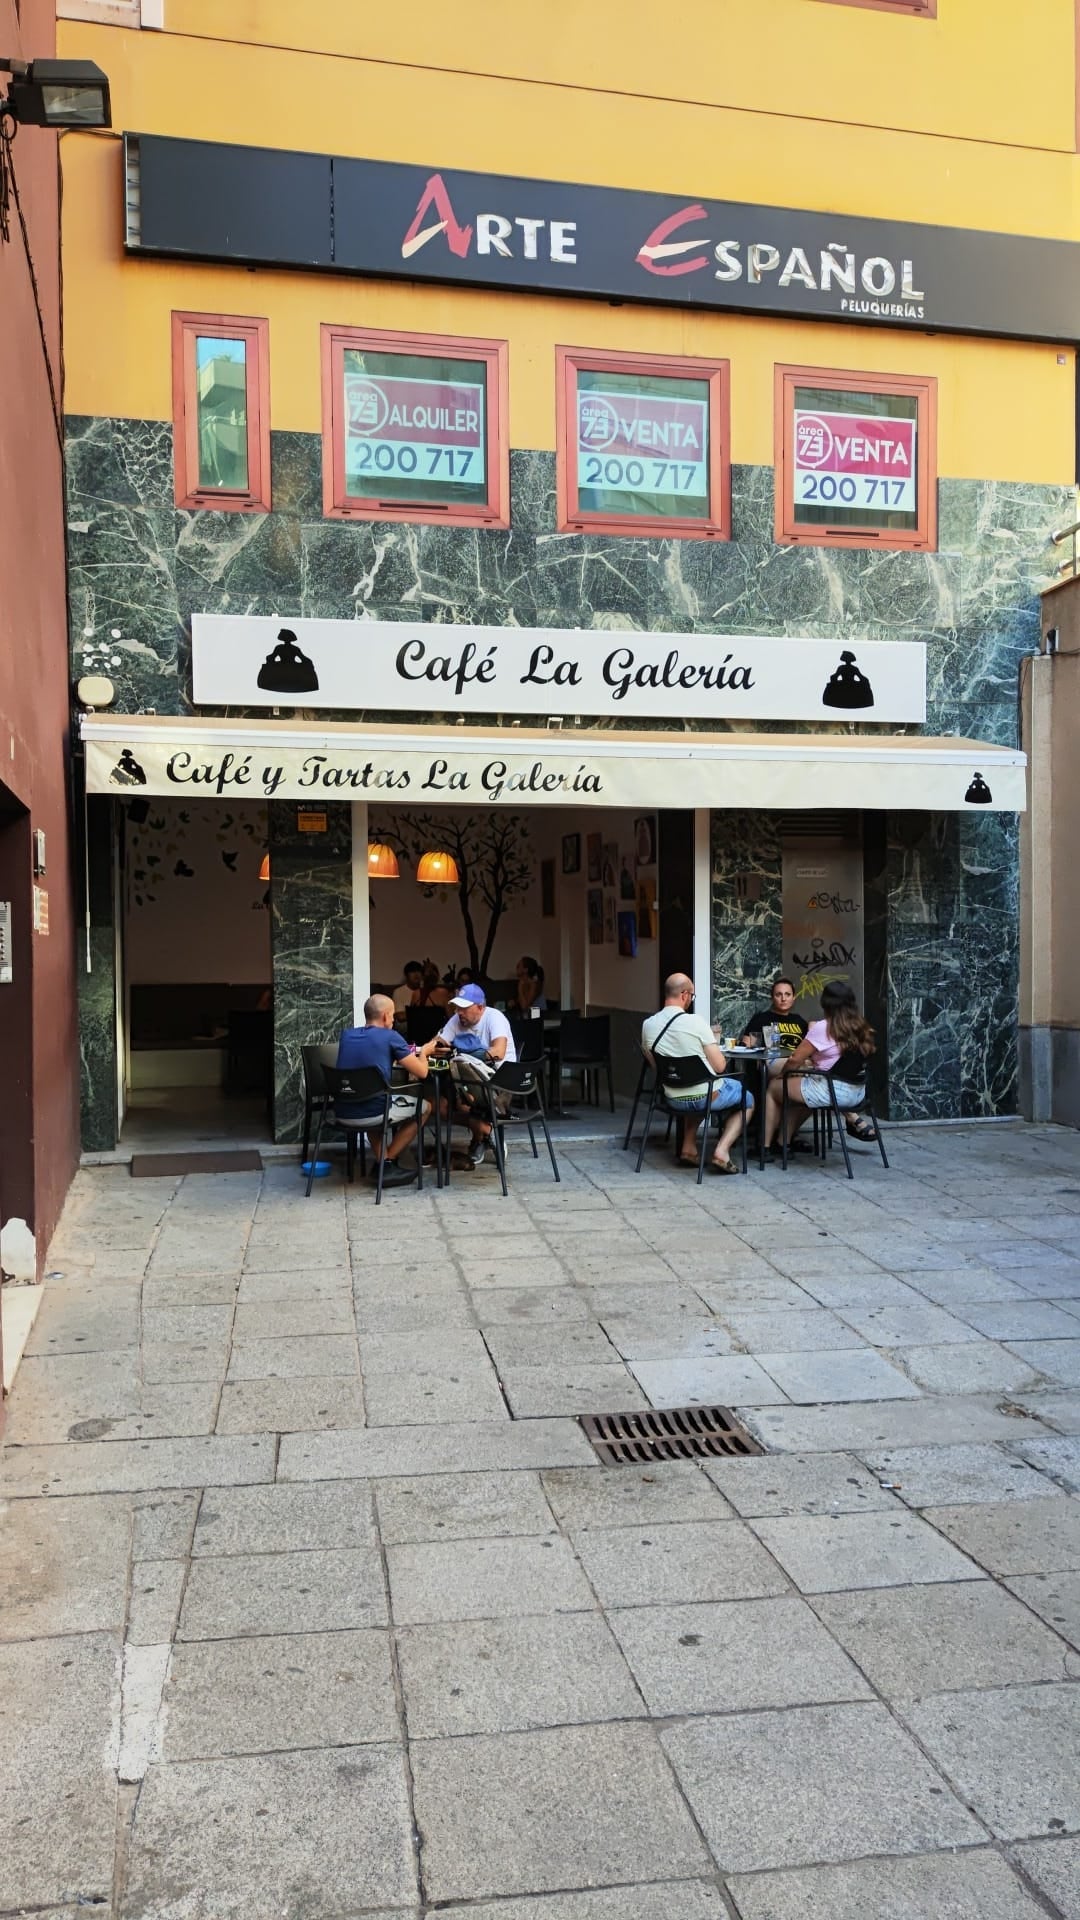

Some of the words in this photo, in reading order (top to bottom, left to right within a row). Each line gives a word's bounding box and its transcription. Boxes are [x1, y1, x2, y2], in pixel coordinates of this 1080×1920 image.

[402, 173, 577, 264] ARTE
[634, 204, 925, 300] ESPAÑOL
[841, 298, 924, 319] PELUQUERÍAS
[350, 401, 378, 425] 73
[389, 404, 478, 432] ALQUILER
[581, 416, 609, 440] 73
[620, 418, 699, 448] VENTA
[798, 425, 824, 436] área
[354, 442, 418, 473] 200
[426, 447, 474, 477] 717
[798, 435, 824, 457] 73
[834, 436, 908, 465] VENTA
[586, 457, 644, 486] 200
[652, 462, 697, 490] 717
[802, 474, 857, 502] 200
[864, 478, 906, 505] 717
[396, 640, 498, 695] Café
[519, 645, 582, 686] La
[602, 648, 755, 700] Galería
[166, 752, 252, 794] Café
[262, 766, 287, 795] y
[298, 756, 410, 788] Tartas
[421, 759, 471, 791] La
[481, 761, 603, 800] Galería
